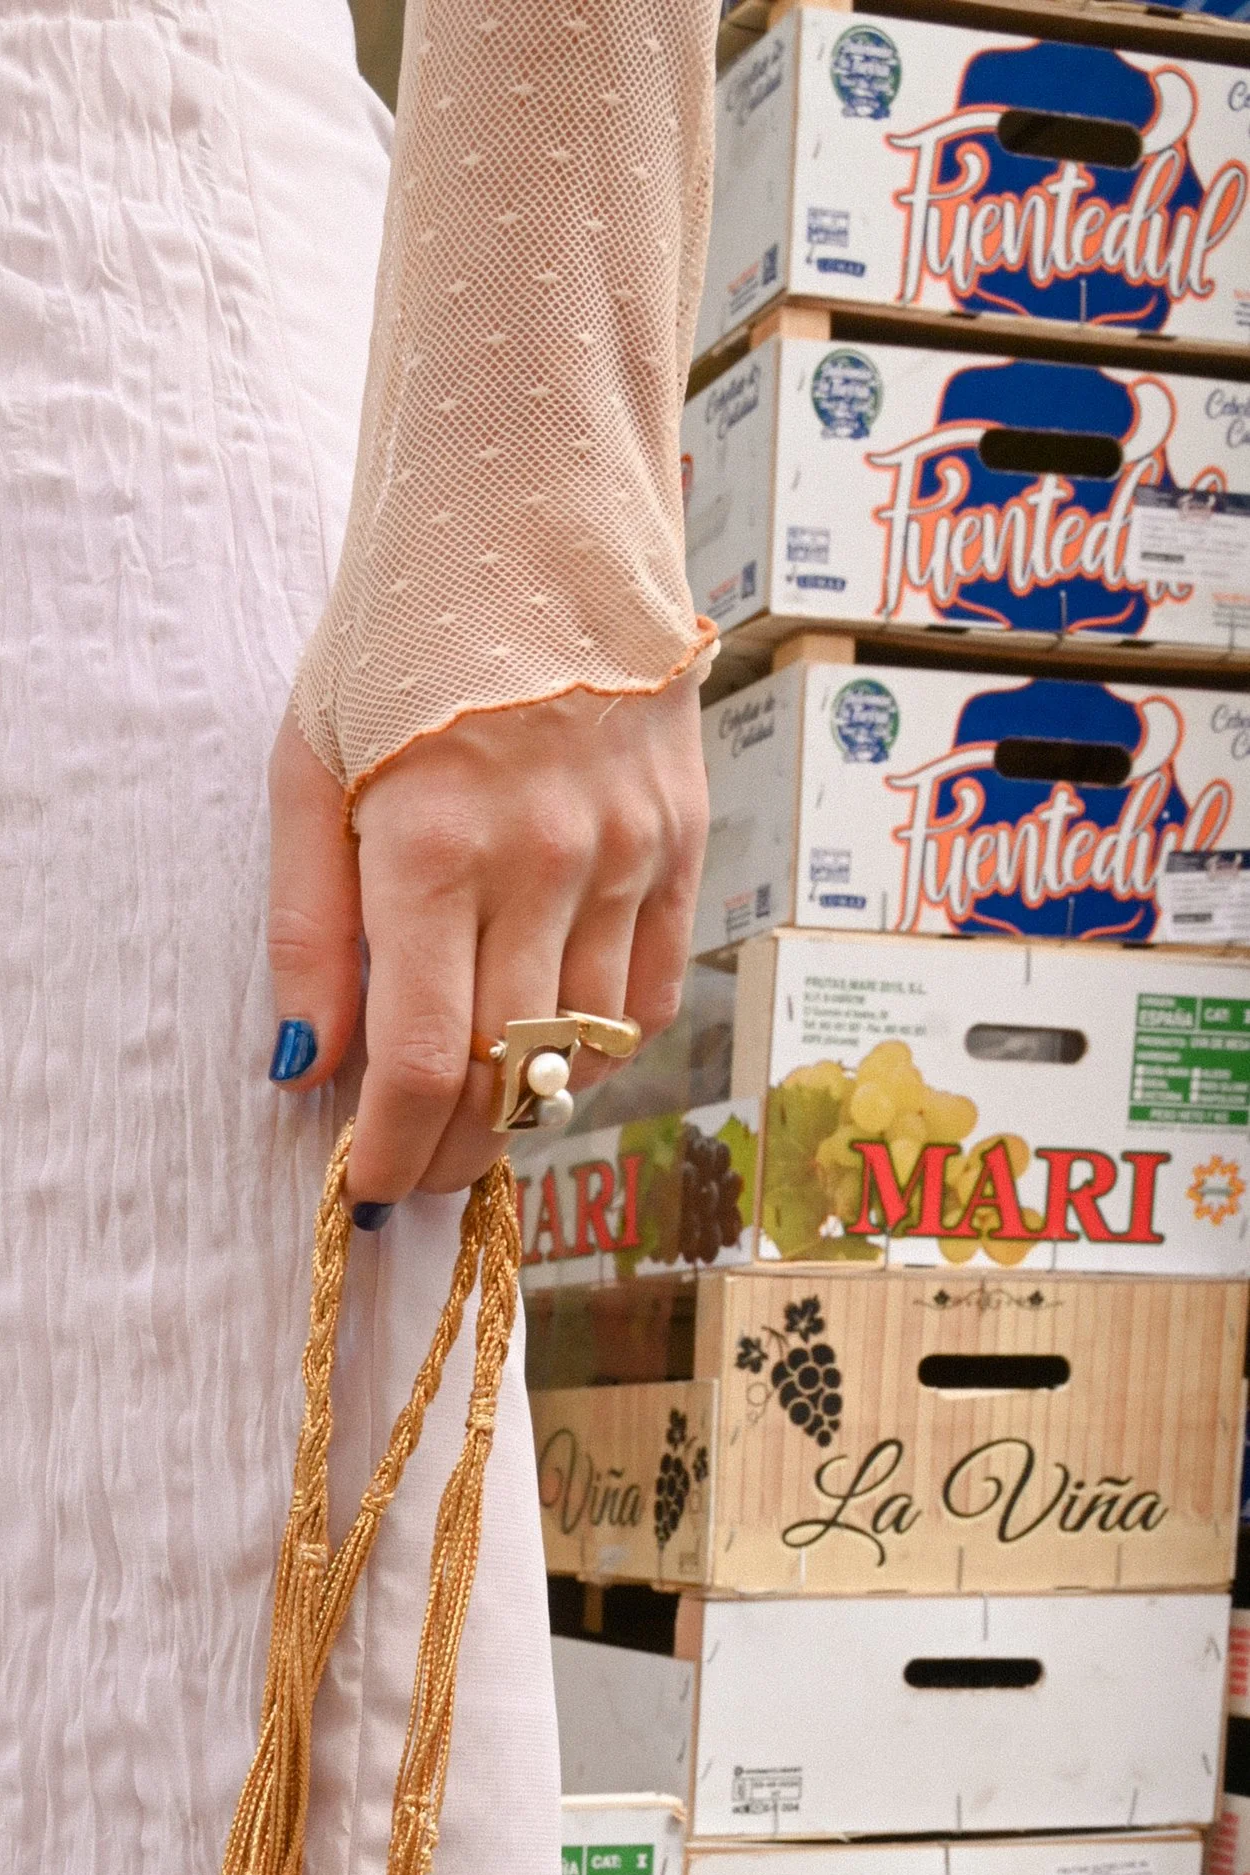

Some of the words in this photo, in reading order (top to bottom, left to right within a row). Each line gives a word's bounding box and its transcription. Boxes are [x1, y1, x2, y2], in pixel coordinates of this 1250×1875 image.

[847, 1135, 1171, 1245] MARI
[537, 1428, 641, 1535] Viña
[782, 1438, 922, 1567] La
[942, 1437, 1168, 1543] Viña
